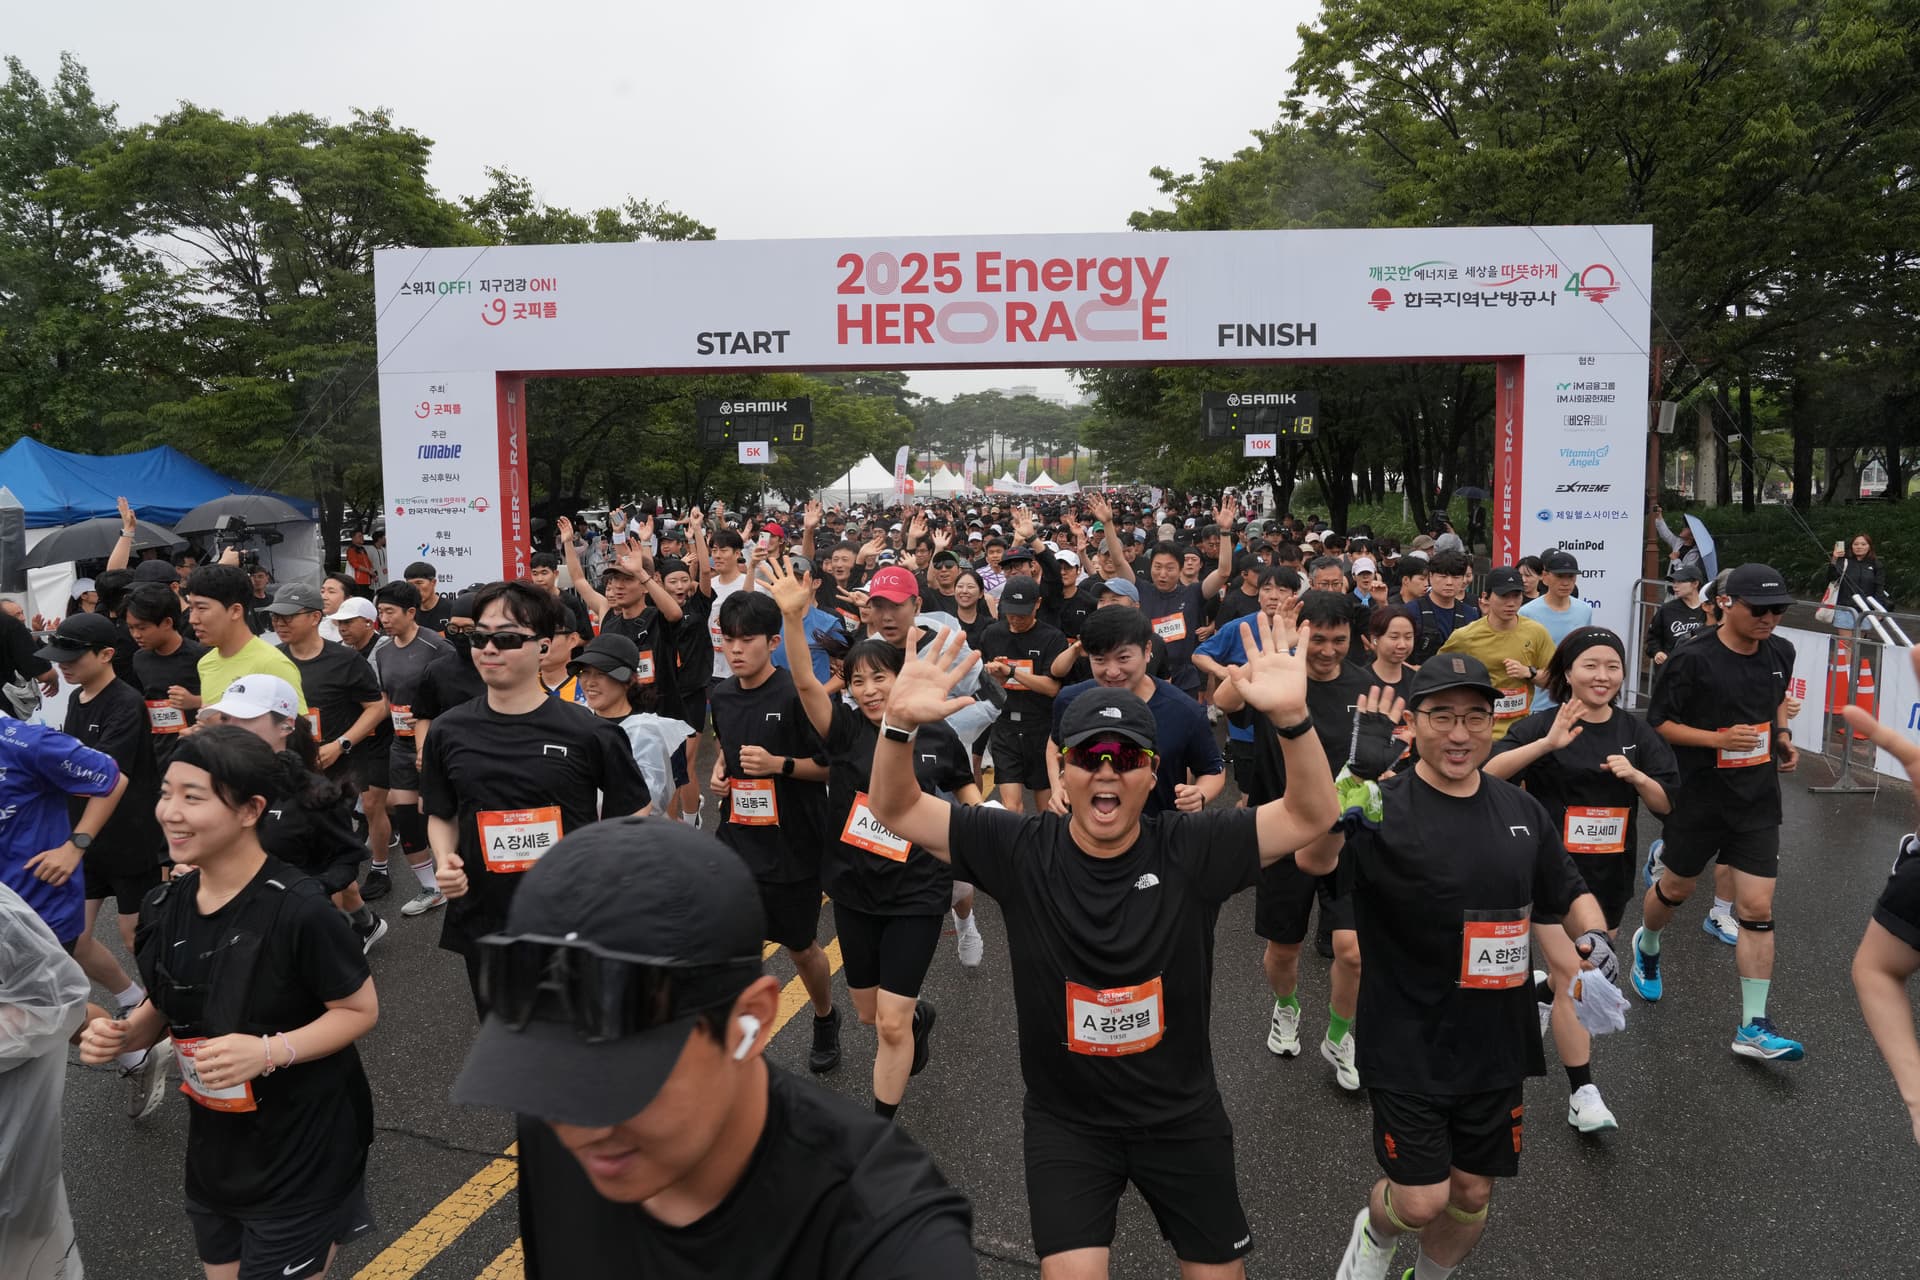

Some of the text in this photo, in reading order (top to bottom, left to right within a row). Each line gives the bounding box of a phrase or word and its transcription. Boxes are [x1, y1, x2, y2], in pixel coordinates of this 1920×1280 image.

[1369, 263, 1558, 281] 깨끗한 에너지로 세상을 따뜻하게
[837, 251, 1170, 306] 2025 Energy
[401, 277, 557, 295] 스위치 OFF! 지구건강 ON!
[1404, 290, 1556, 308] 한국지역난방공사
[512, 302, 557, 319] 굿피플
[837, 301, 1000, 345] HERO
[1217, 322, 1317, 347] FINISH
[697, 329, 790, 355] START
[1578, 356, 1595, 366] 협찬
[429, 385, 445, 393] 주최
[1241, 393, 1297, 405] SAMIK
[434, 403, 462, 415] 굿피플
[733, 401, 788, 413] SAMIK
[1293, 416, 1312, 434] 18
[431, 430, 447, 439] 주관
[1251, 440, 1271, 449] 10K
[417, 444, 462, 459] runable
[746, 448, 760, 457] 5K
[1559, 448, 1597, 458] Vitamin
[1568, 457, 1600, 468] Angels
[421, 473, 460, 482] 공식후원사
[1555, 481, 1611, 493] EXTREME
[1556, 511, 1629, 519] 제일헬스사이언스
[435, 531, 451, 539] 후원
[1558, 539, 1605, 551] PlainPod
[431, 546, 472, 557] 서울특별시
[873, 575, 900, 588] NYC
[741, 797, 768, 809] 김동국
[857, 816, 868, 829] A
[1574, 825, 1618, 836] A 김세미
[493, 832, 550, 850] A 장세훈
[1477, 949, 1492, 964] A
[1083, 1008, 1151, 1033] A 강성열
